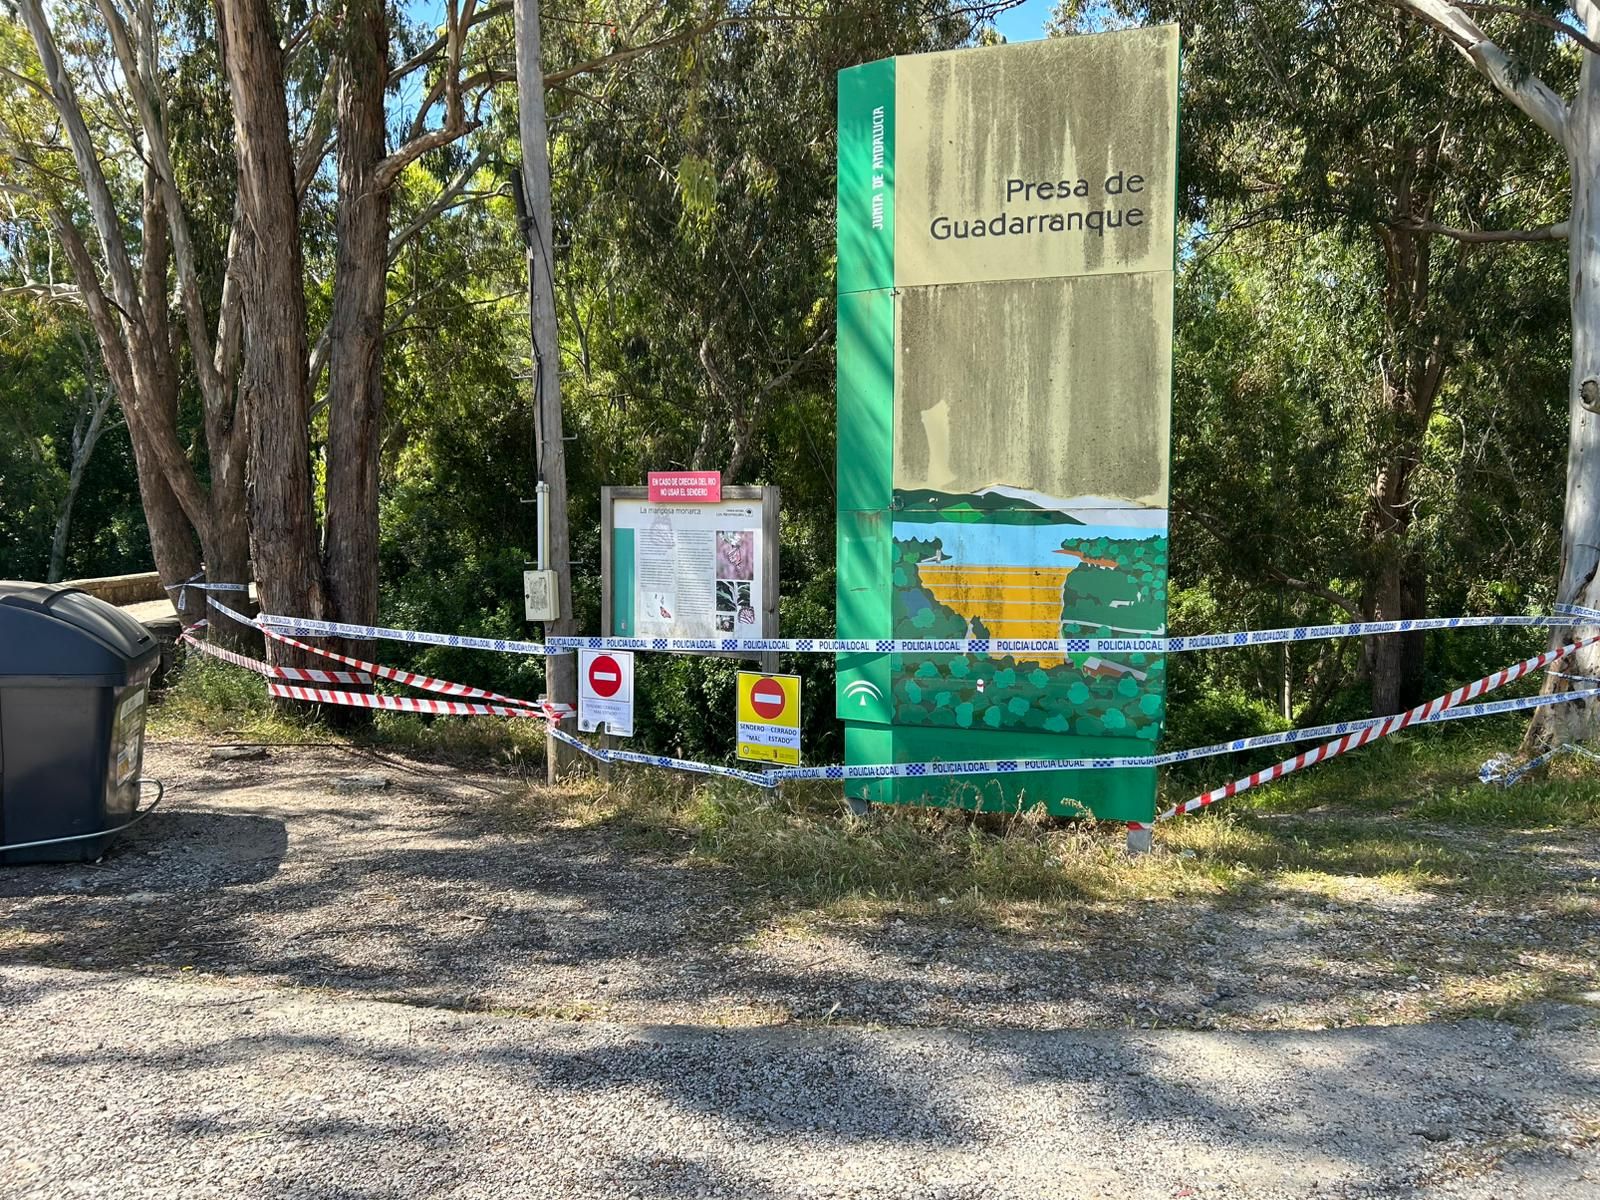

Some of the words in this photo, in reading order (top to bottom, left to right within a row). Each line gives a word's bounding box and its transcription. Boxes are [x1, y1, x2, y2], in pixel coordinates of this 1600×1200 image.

[872, 173, 884, 190] DE
[1006, 178, 1089, 202] Presa
[1104, 171, 1145, 195] de
[872, 193, 883, 231] JUNTA
[930, 206, 1144, 240] Guadarranque
[652, 478, 658, 486] EN
[659, 478, 671, 486] CASO
[672, 478, 678, 486] DE
[698, 478, 707, 486] DEL
[660, 488, 667, 496] NO
[668, 488, 679, 496] USAR
[680, 488, 686, 496] EL
[686, 488, 708, 496] SENDERO
[640, 506, 647, 514] La
[1252, 633, 1272, 642] POLICIA
[1273, 632, 1289, 640] LOCAL
[1310, 628, 1329, 637] POLICIA
[1329, 627, 1344, 635] LOCAL
[462, 637, 477, 646] POLICIA
[478, 639, 491, 648] LOCAL
[567, 638, 584, 646] LOCAL
[607, 639, 627, 647] POLICIA
[628, 640, 647, 648] LOCAL
[673, 640, 695, 648] POLICIA
[696, 640, 716, 648] LOCAL
[743, 640, 767, 649] POLICIA
[769, 641, 790, 649] LOCAL
[819, 641, 845, 650] POLICIA
[846, 641, 869, 650] LOCAL
[902, 641, 932, 650] POLICIA
[934, 641, 960, 650] LOCAL
[997, 641, 1028, 651] POLICIA
[1031, 641, 1059, 651] LOCAL
[1098, 640, 1130, 650] POLICIA
[1133, 640, 1163, 650] LOCAL
[1189, 637, 1210, 648] POLICIA
[1211, 636, 1229, 646] LOCAL
[740, 724, 764, 732] SENDERO
[771, 727, 797, 736] CERRADO
[1301, 729, 1318, 738] POLICIA
[1318, 727, 1333, 736] LOCAL
[933, 763, 960, 773] POLICIA
[964, 762, 990, 772] LOCAL
[1025, 760, 1056, 768] POLICIA
[774, 770, 798, 778] POLICIA
[800, 770, 820, 778] LOCAL
[849, 767, 875, 776] POLICIA
[876, 766, 899, 775] LOCAL
